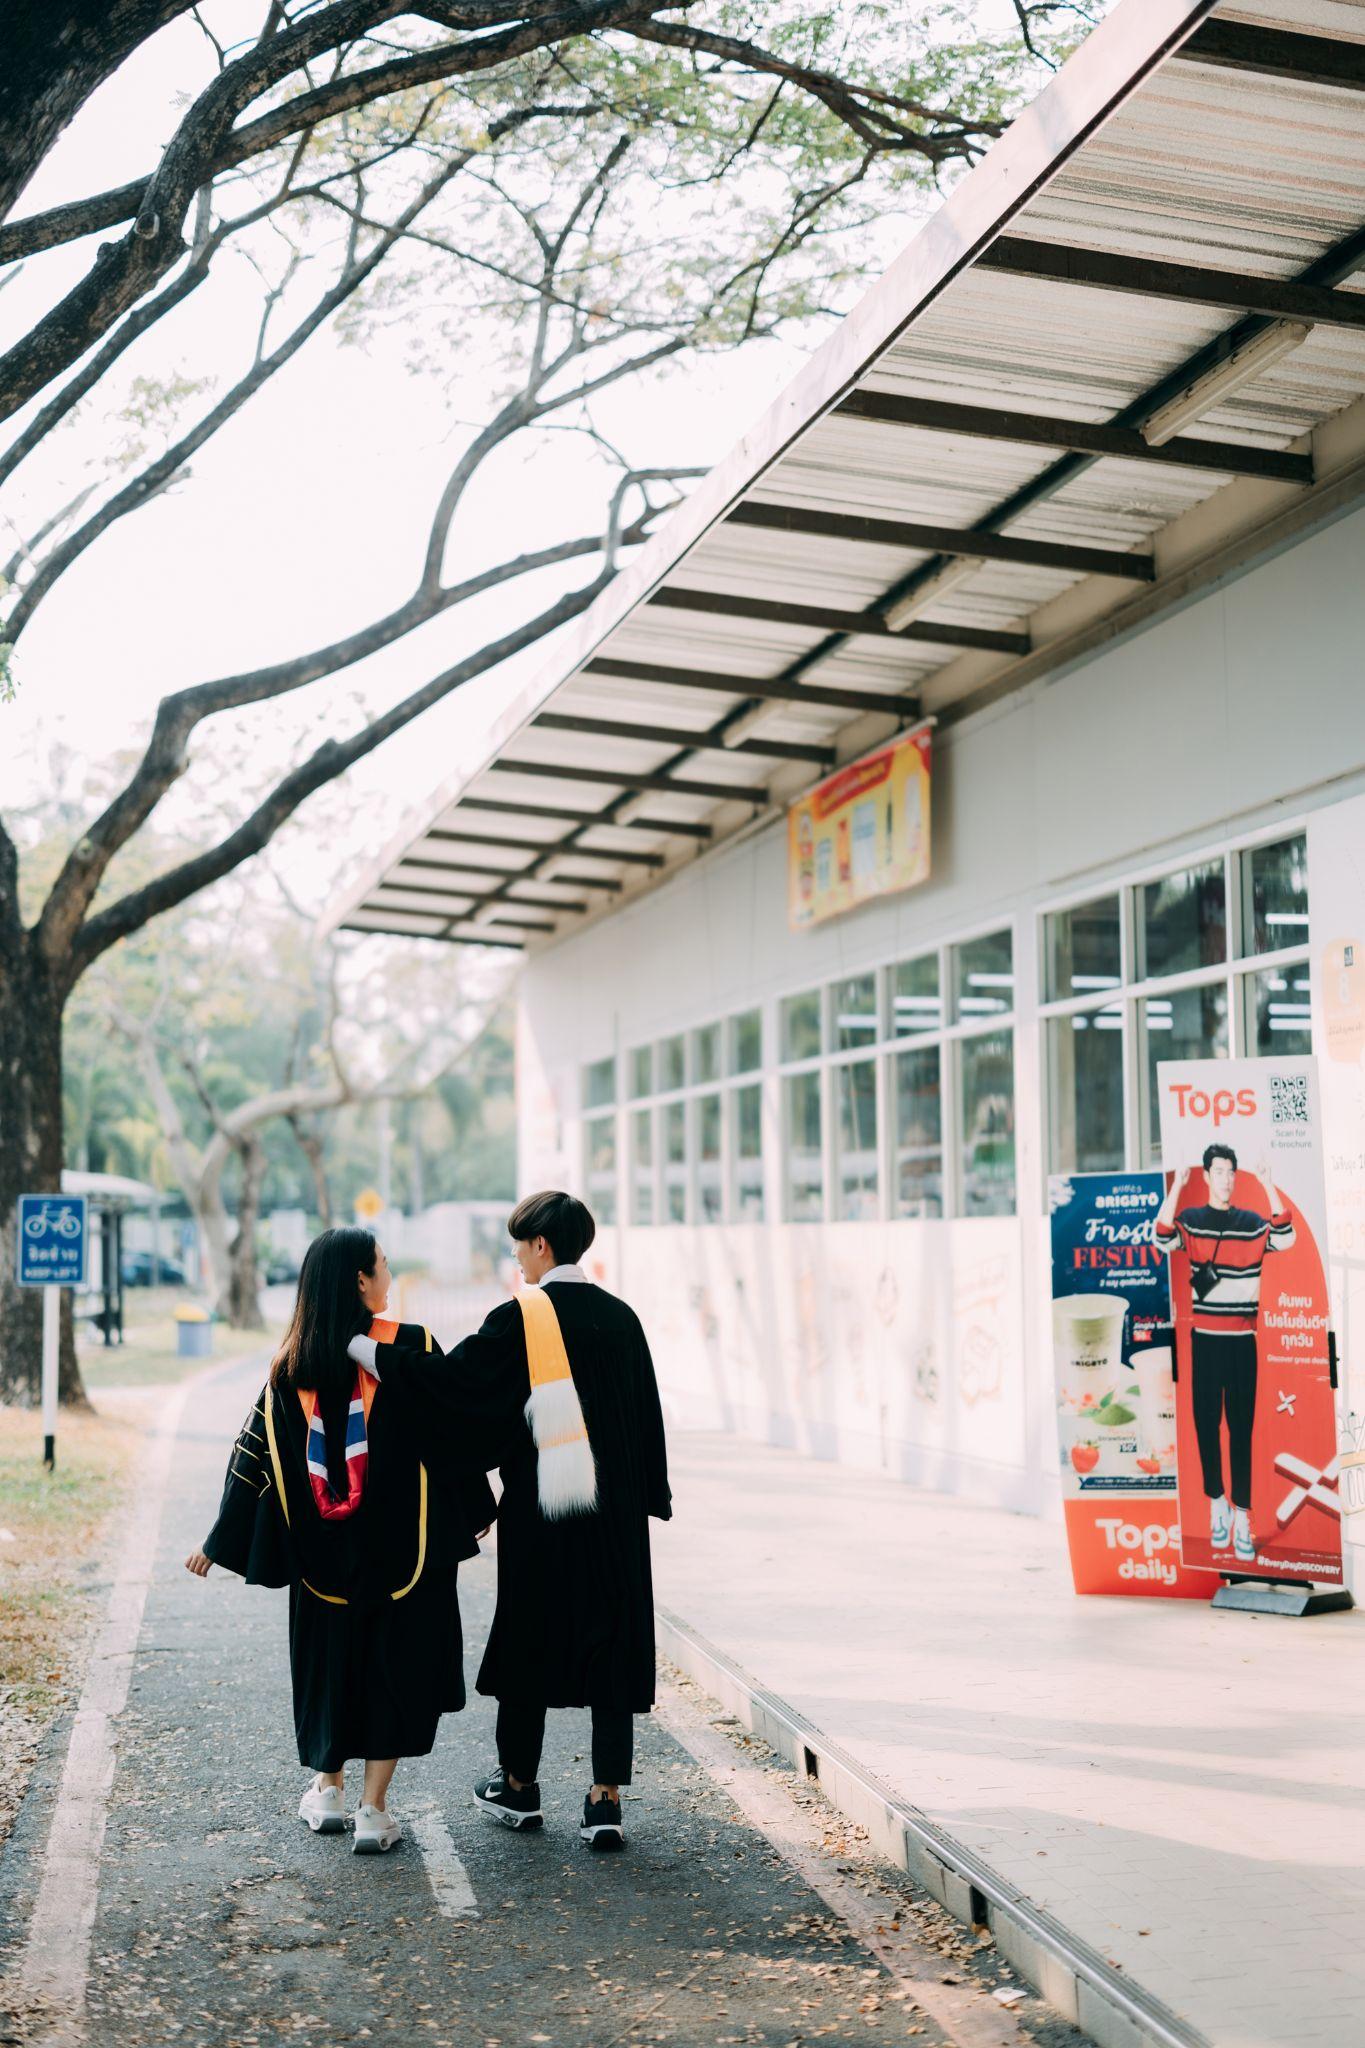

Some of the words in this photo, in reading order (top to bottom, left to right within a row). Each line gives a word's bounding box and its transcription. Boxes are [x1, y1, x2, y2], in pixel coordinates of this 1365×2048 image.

[1168, 1083, 1257, 1127] Tops
[1275, 1129, 1294, 1137] Scan
[1295, 1128, 1306, 1137] for
[1270, 1140, 1312, 1149] E-brochure
[1278, 1291, 1313, 1308] ค้นพบ
[1281, 1332, 1314, 1351] ทุกวัน
[1095, 1518, 1181, 1557] Tops
[1118, 1557, 1177, 1585] daily
